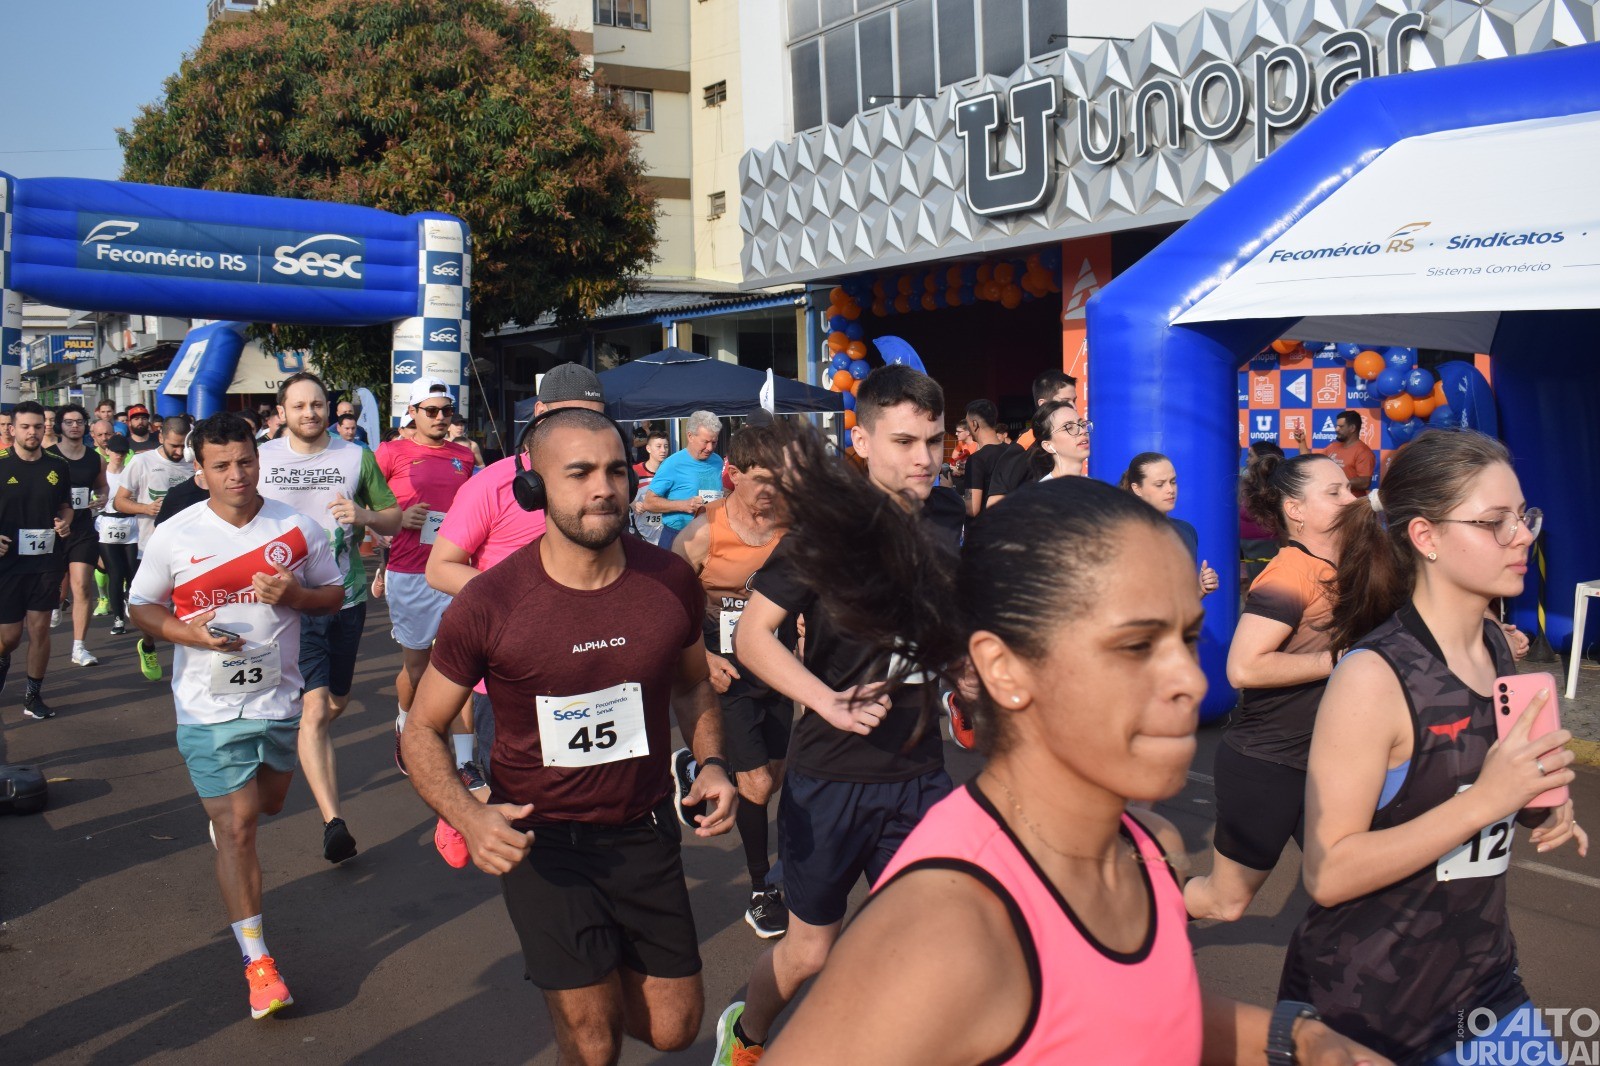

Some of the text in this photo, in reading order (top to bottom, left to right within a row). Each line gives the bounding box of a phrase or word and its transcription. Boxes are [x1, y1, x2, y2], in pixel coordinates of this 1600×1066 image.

[1268, 231, 1565, 264] Fecomércio RS Sindicatos
[96, 243, 247, 272] Fecomércio RS
[272, 234, 362, 280] Sesc
[432, 261, 460, 277] Sesc
[1425, 262, 1552, 277] Sistema Comércio
[429, 328, 458, 343] Sesc
[394, 360, 417, 375] Sesc
[1250, 431, 1278, 441] unopar
[289, 466, 341, 476] RÚSTICA
[264, 475, 346, 484] LIONS SEBERI
[107, 531, 126, 540] 149
[29, 540, 46, 551] 14
[572, 636, 626, 653] ALPHA CO
[222, 656, 249, 668] Sesc
[229, 667, 263, 686] 43
[553, 702, 591, 721] Sesc
[568, 720, 618, 753] 45
